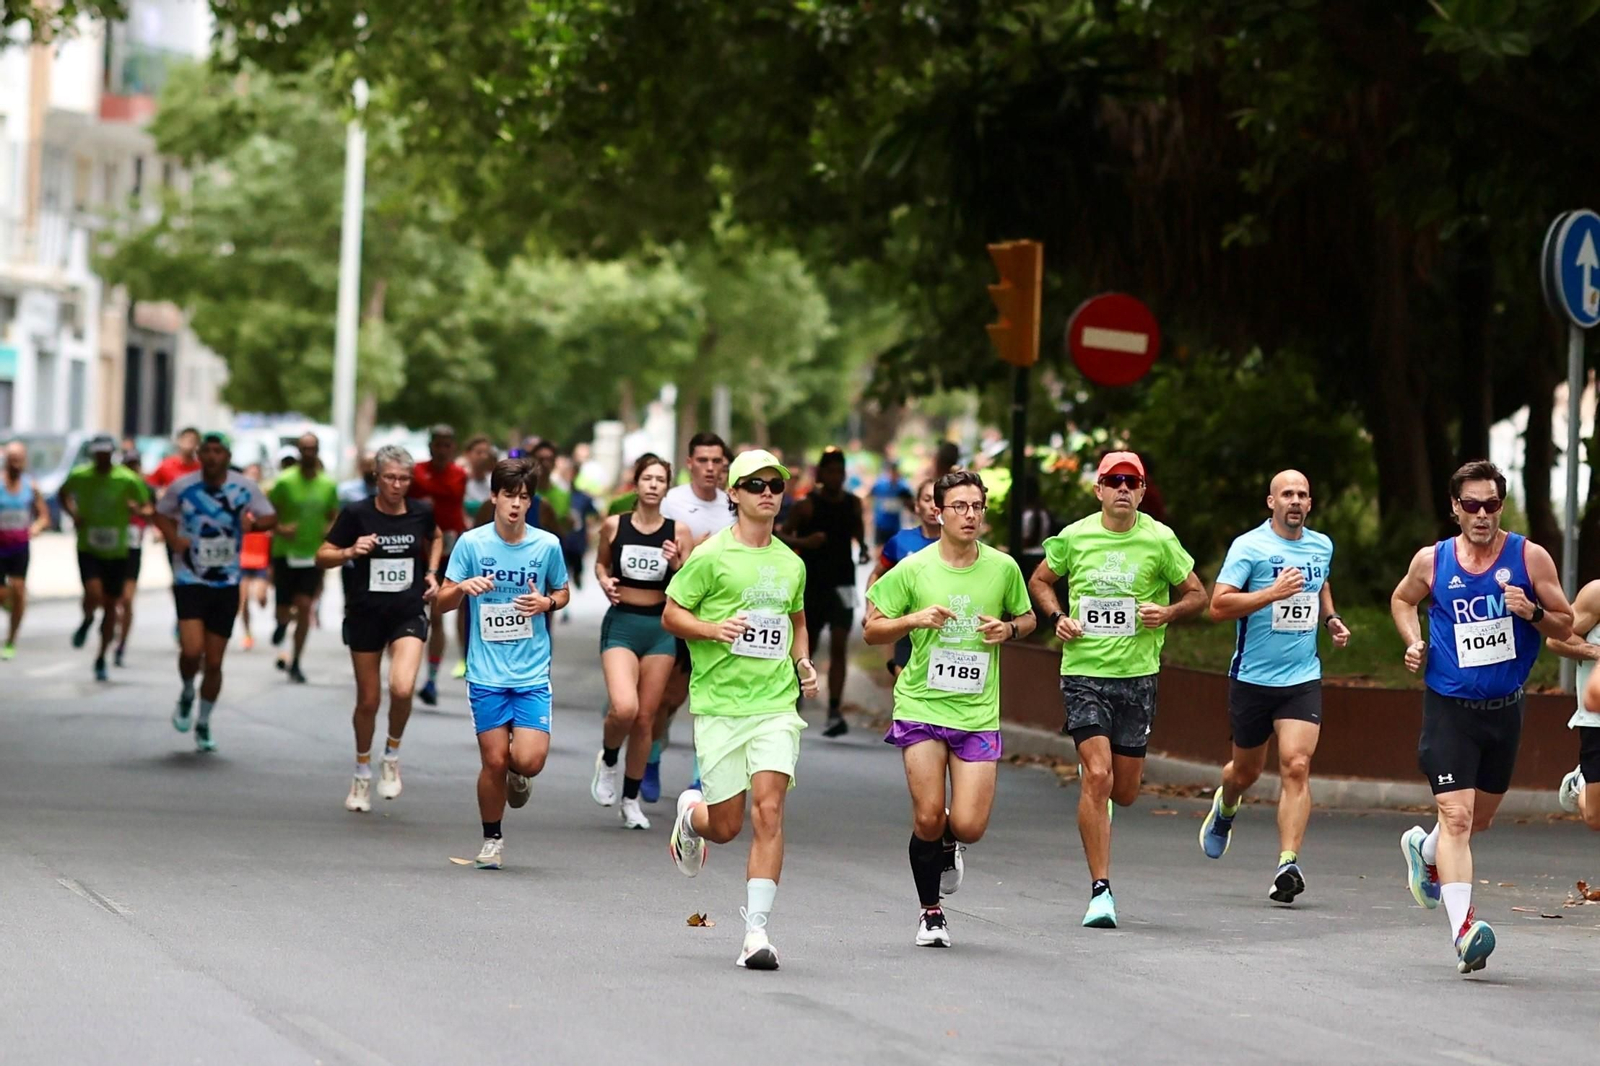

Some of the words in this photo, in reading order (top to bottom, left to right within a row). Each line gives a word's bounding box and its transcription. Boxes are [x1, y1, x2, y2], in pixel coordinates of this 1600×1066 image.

[376, 534, 416, 545] OYSHO
[627, 557, 659, 571] 302
[377, 570, 406, 582] 108
[1280, 605, 1312, 619] 767
[1452, 592, 1512, 623] RCM
[485, 614, 526, 628] 1030
[1087, 609, 1126, 625] 618
[742, 627, 781, 646] 619
[1462, 631, 1508, 651] 1044
[935, 663, 980, 681] 1189
